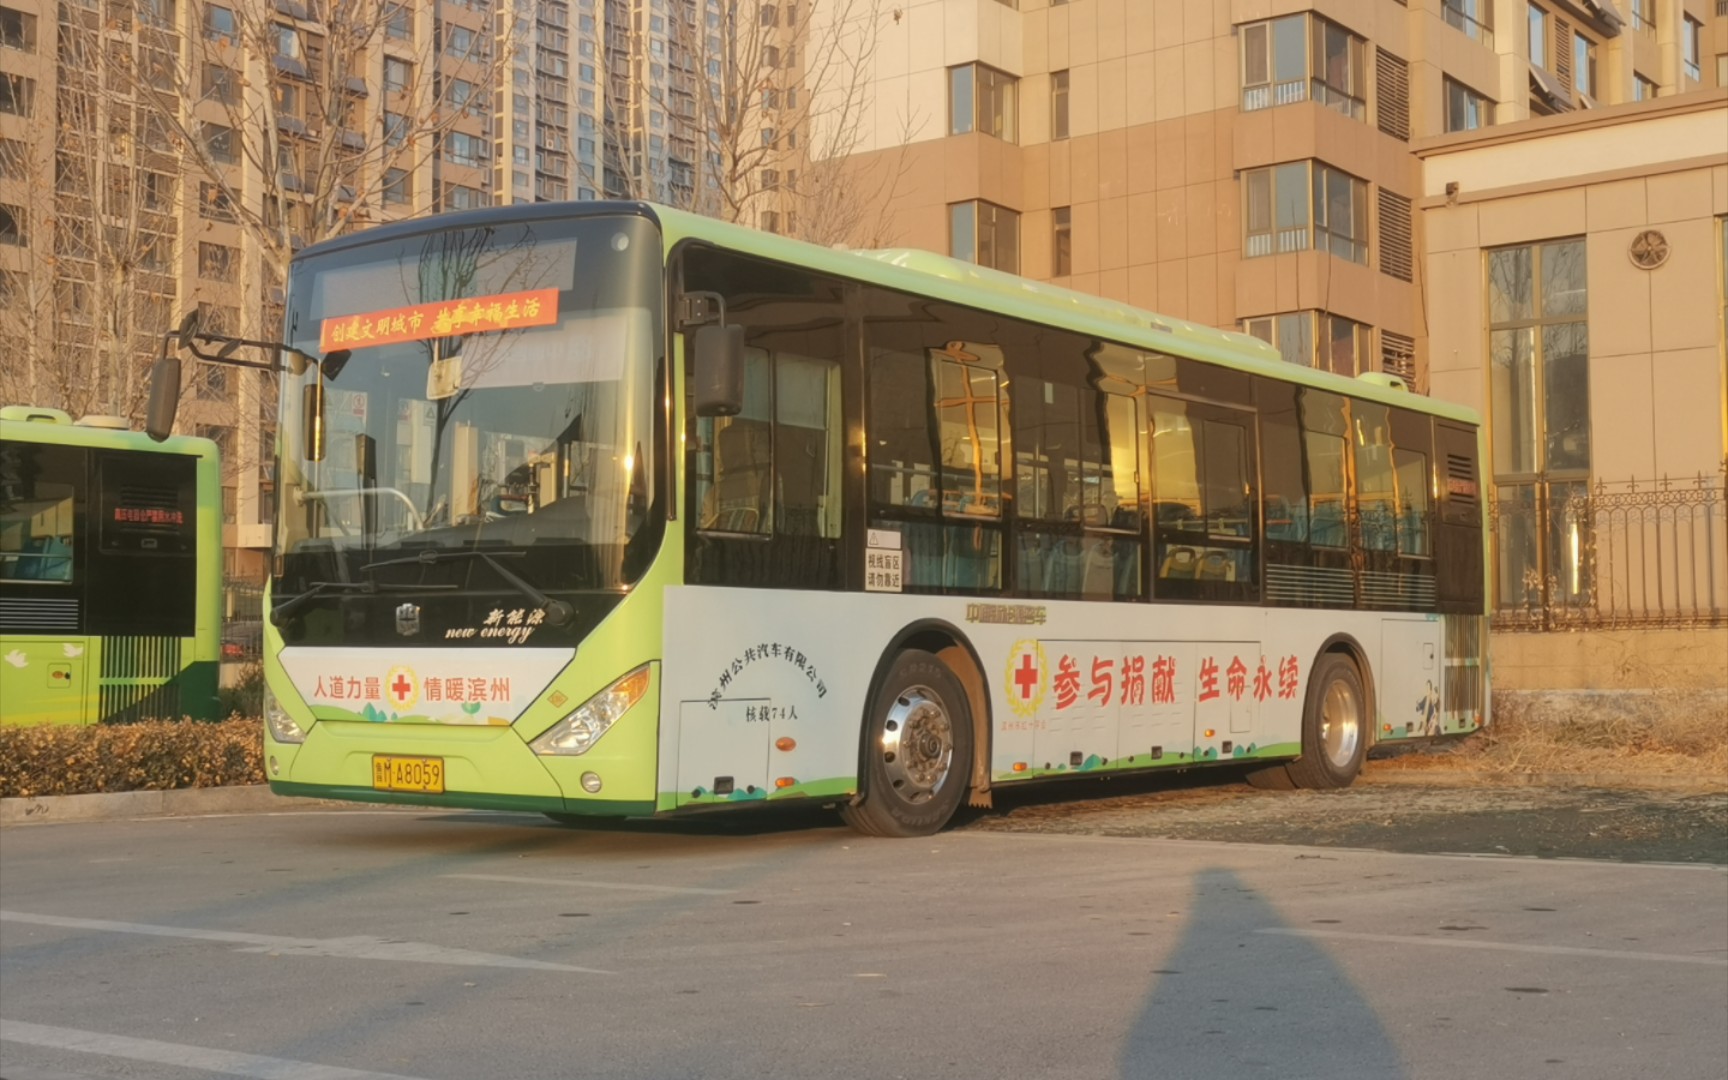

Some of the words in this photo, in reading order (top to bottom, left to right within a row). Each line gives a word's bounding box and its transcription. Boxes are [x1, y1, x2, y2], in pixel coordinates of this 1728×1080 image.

[331, 310, 425, 342] 创建文明城市
[868, 553, 900, 570] 视线盲区
[867, 572, 900, 588] 请勿靠近
[483, 608, 545, 627] 新能源
[445, 627, 478, 639] new
[480, 626, 535, 644] energy
[708, 642, 828, 711] 滨州公共汽车有限公司
[1053, 653, 1177, 711] 参与捐献
[1198, 653, 1299, 703] 生命永续
[313, 675, 381, 700] 人道力量
[423, 676, 511, 703] 情暖滨州
[745, 704, 798, 722] 核载74人
